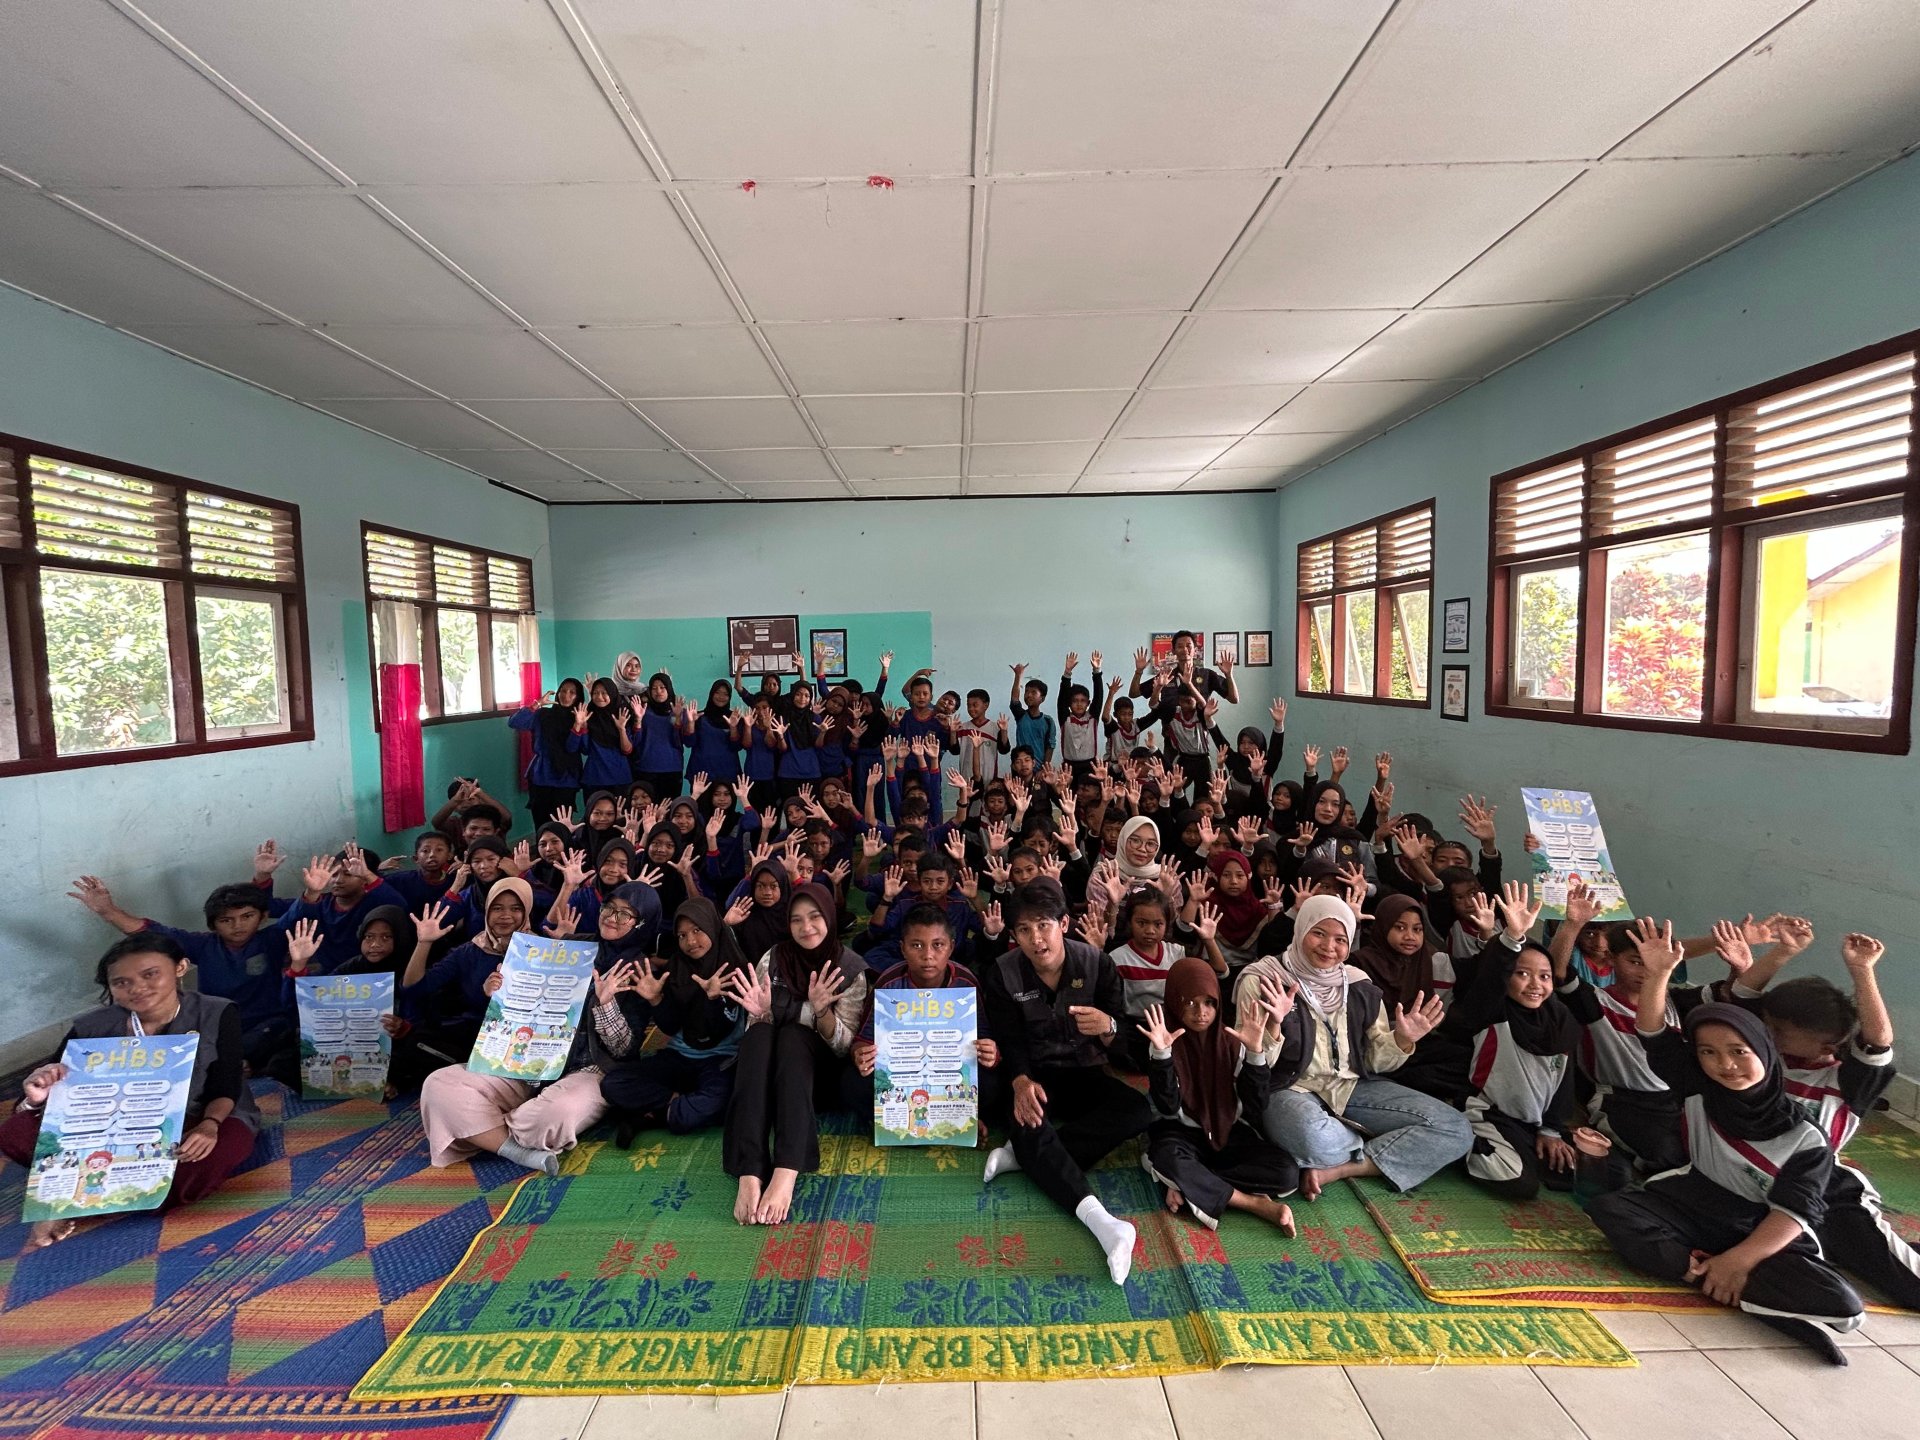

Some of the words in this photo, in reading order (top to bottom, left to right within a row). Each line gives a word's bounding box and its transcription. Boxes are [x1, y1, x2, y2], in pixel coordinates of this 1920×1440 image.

[1540, 798, 1583, 815] PHBS
[526, 946, 581, 966] PHBS
[315, 984, 373, 1000] PHBS
[895, 999, 956, 1020] PHBS
[86, 1048, 167, 1072] PHBS
[836, 1328, 972, 1371] BRAND
[981, 1328, 1167, 1370] JANGKAR
[1236, 1318, 1380, 1353] BRAND
[1387, 1317, 1576, 1354] JANGKAR
[416, 1336, 562, 1376] BRAND
[567, 1335, 753, 1374] JANGKAR
